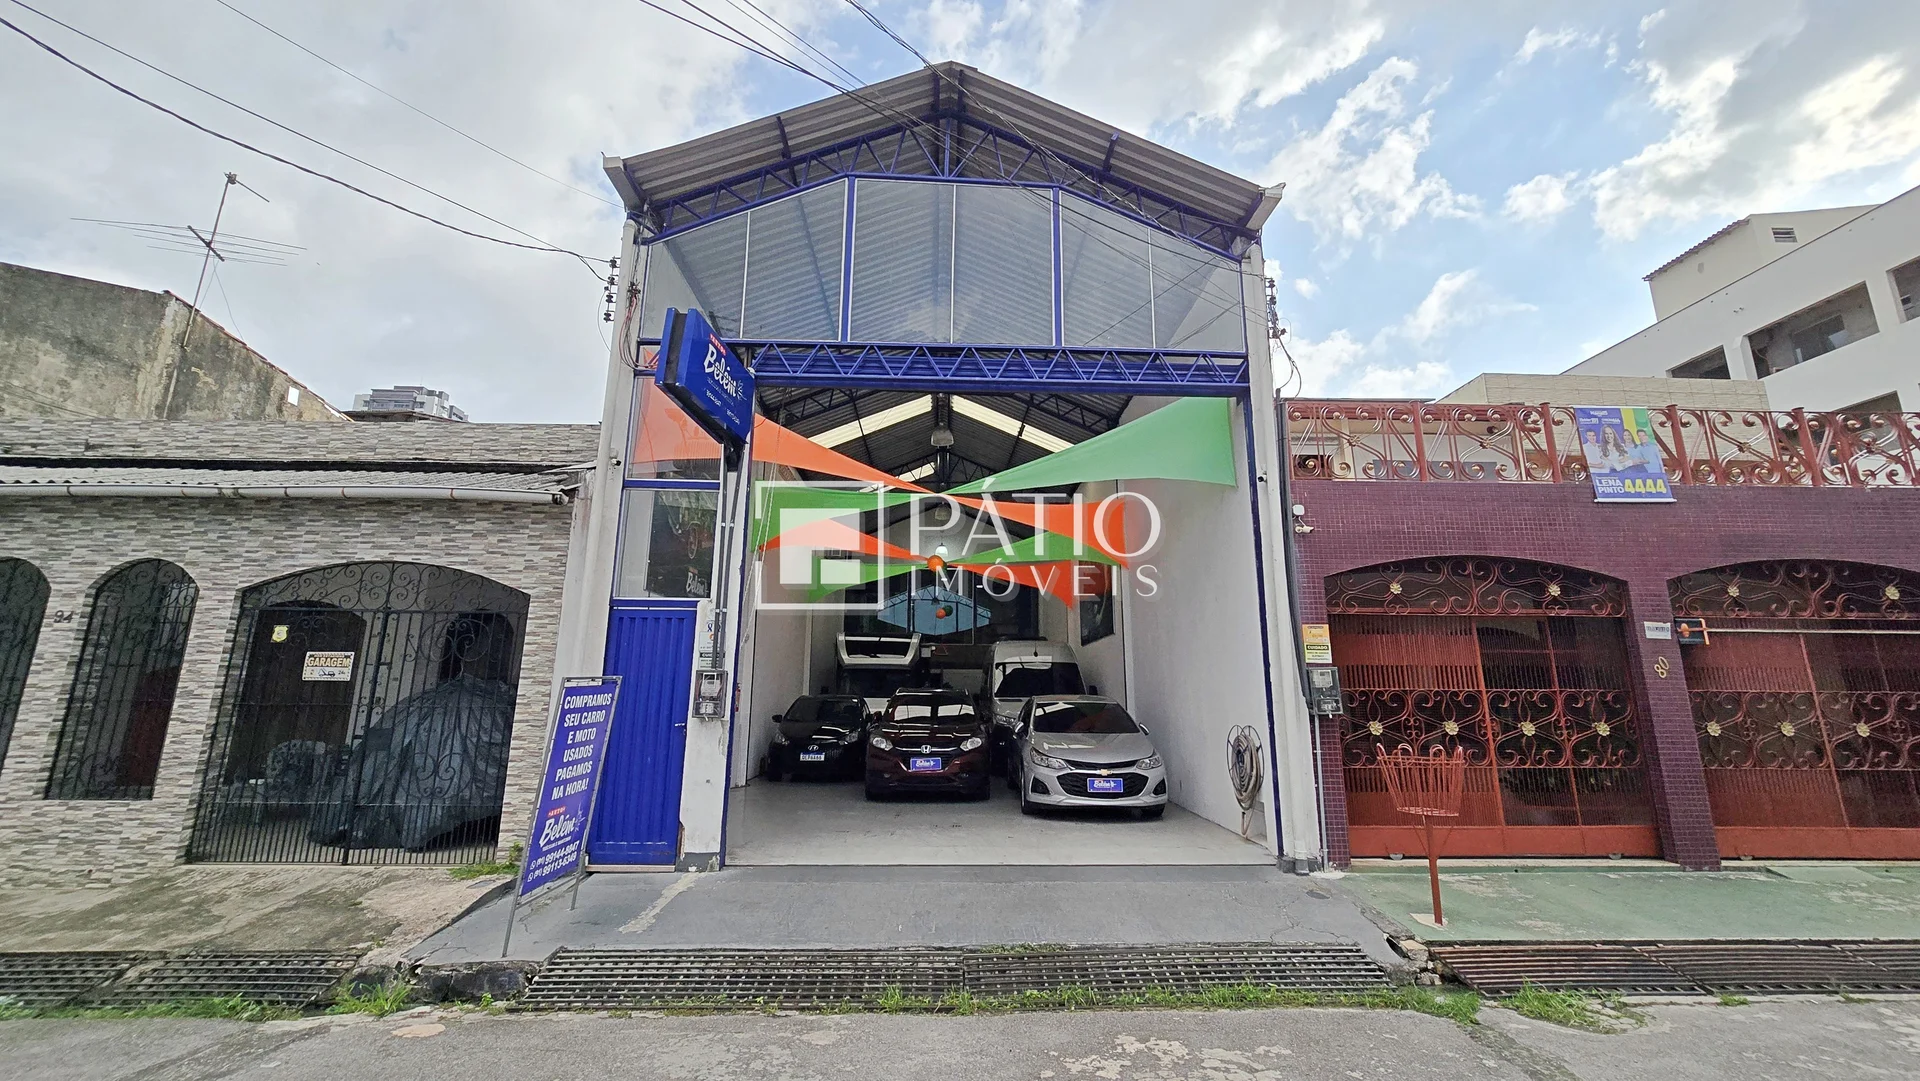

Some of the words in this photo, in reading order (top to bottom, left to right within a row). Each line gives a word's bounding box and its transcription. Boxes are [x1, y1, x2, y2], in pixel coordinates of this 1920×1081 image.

[1595, 478, 1623, 487] LENA
[1598, 486, 1625, 494] PINTO
[1624, 478, 1667, 494] 4444
[53, 609, 75, 623] 94
[308, 657, 350, 667] GARAGEM
[1654, 656, 1670, 679] 80
[564, 693, 613, 709] COMPRAMOS
[564, 713, 581, 727] SEU
[581, 710, 606, 725] CARRO
[567, 731, 574, 744] E
[574, 727, 597, 743] MOTO
[563, 744, 594, 763] USADOS
[555, 760, 593, 782] PAGAMOS
[551, 785, 564, 800] NA
[565, 777, 589, 797] HORA!
[539, 814, 576, 848] Belém
